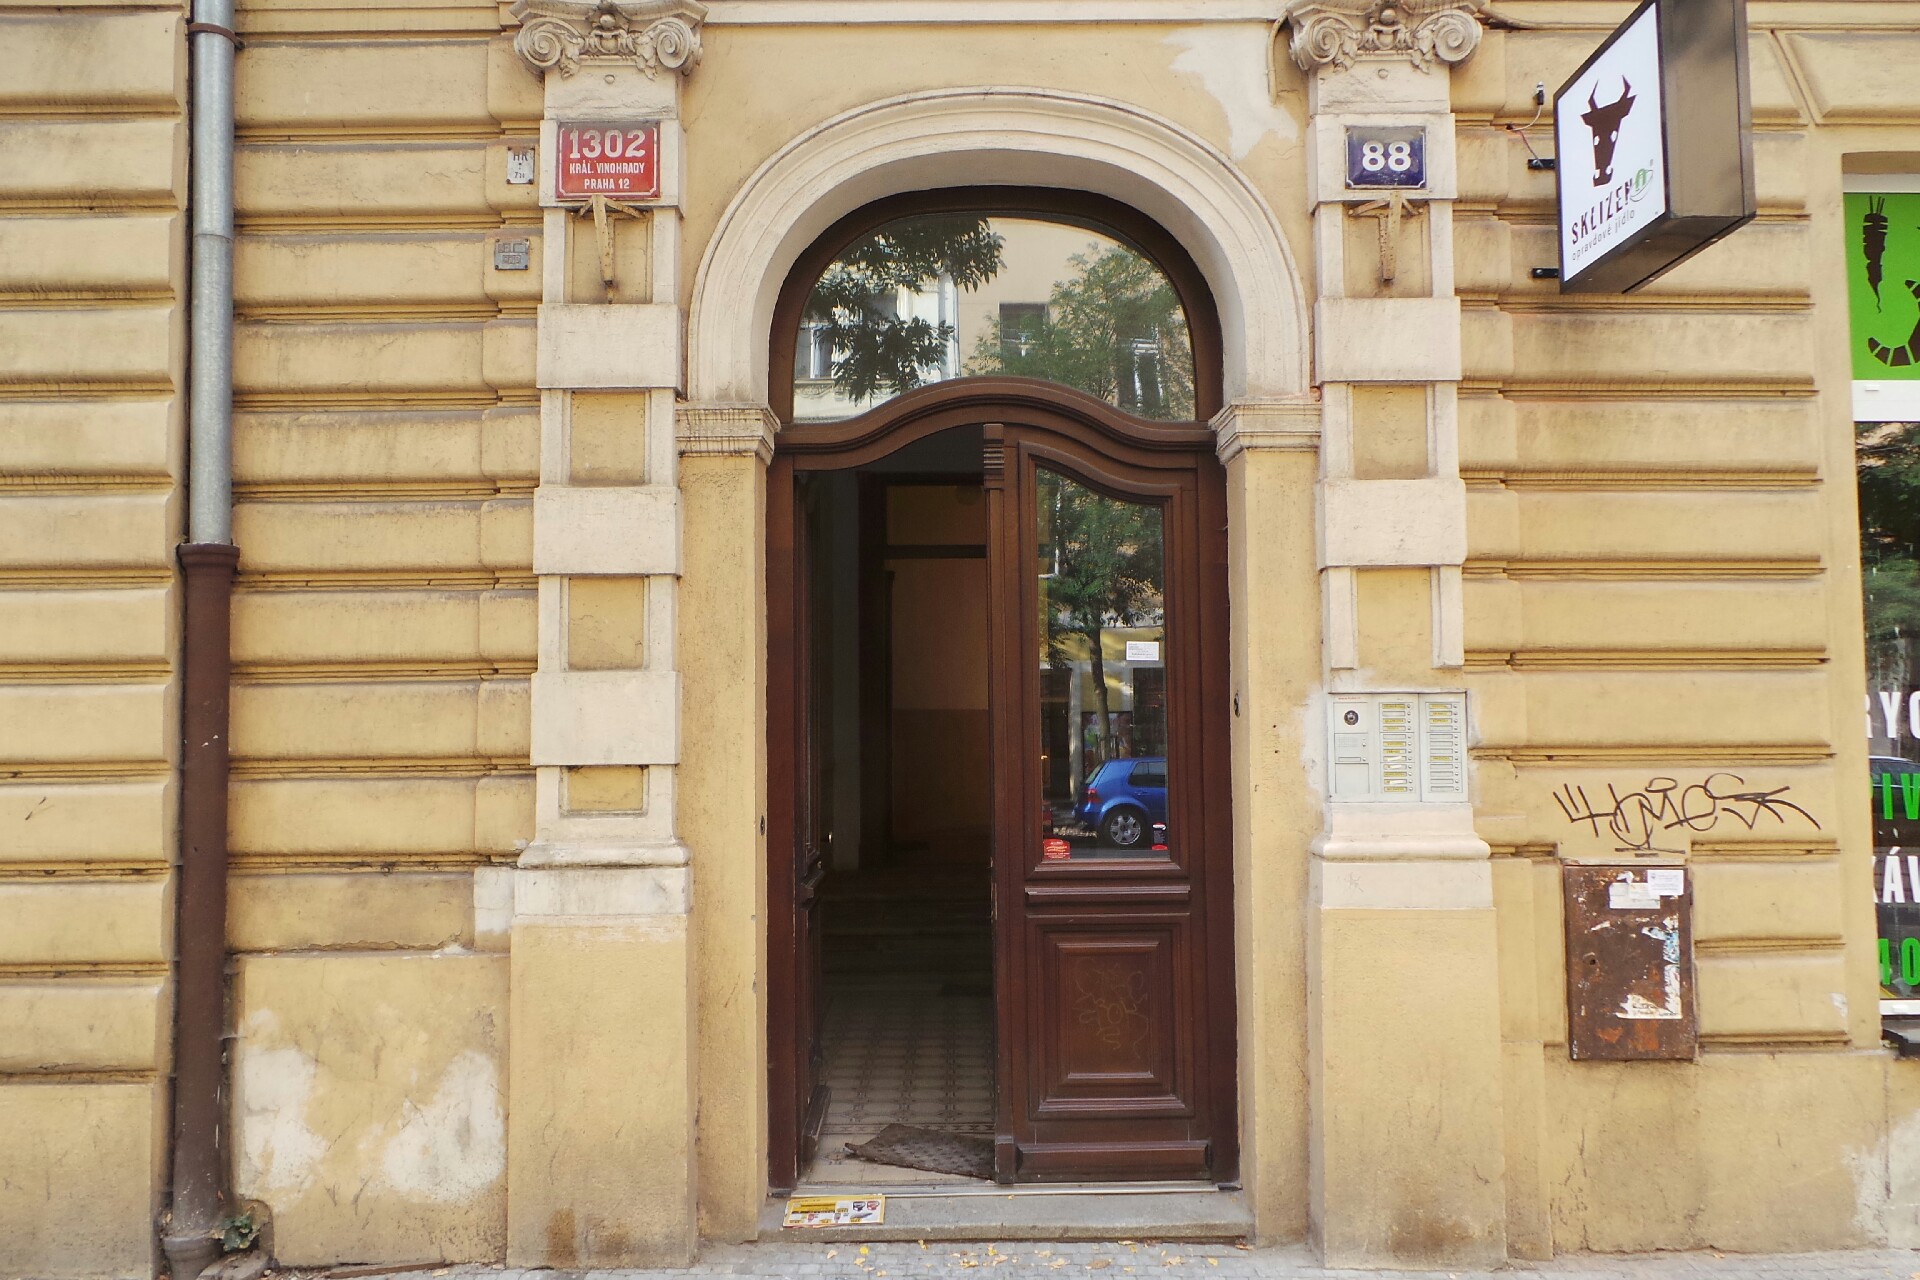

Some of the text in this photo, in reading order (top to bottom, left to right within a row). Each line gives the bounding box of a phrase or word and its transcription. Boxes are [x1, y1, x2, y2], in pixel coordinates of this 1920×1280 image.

[569, 129, 646, 159] 1302
[1362, 140, 1411, 172] 88
[596, 162, 645, 174] VINOHRADY
[584, 178, 630, 190] PRAHA 12
[1870, 773, 1920, 820] IV
